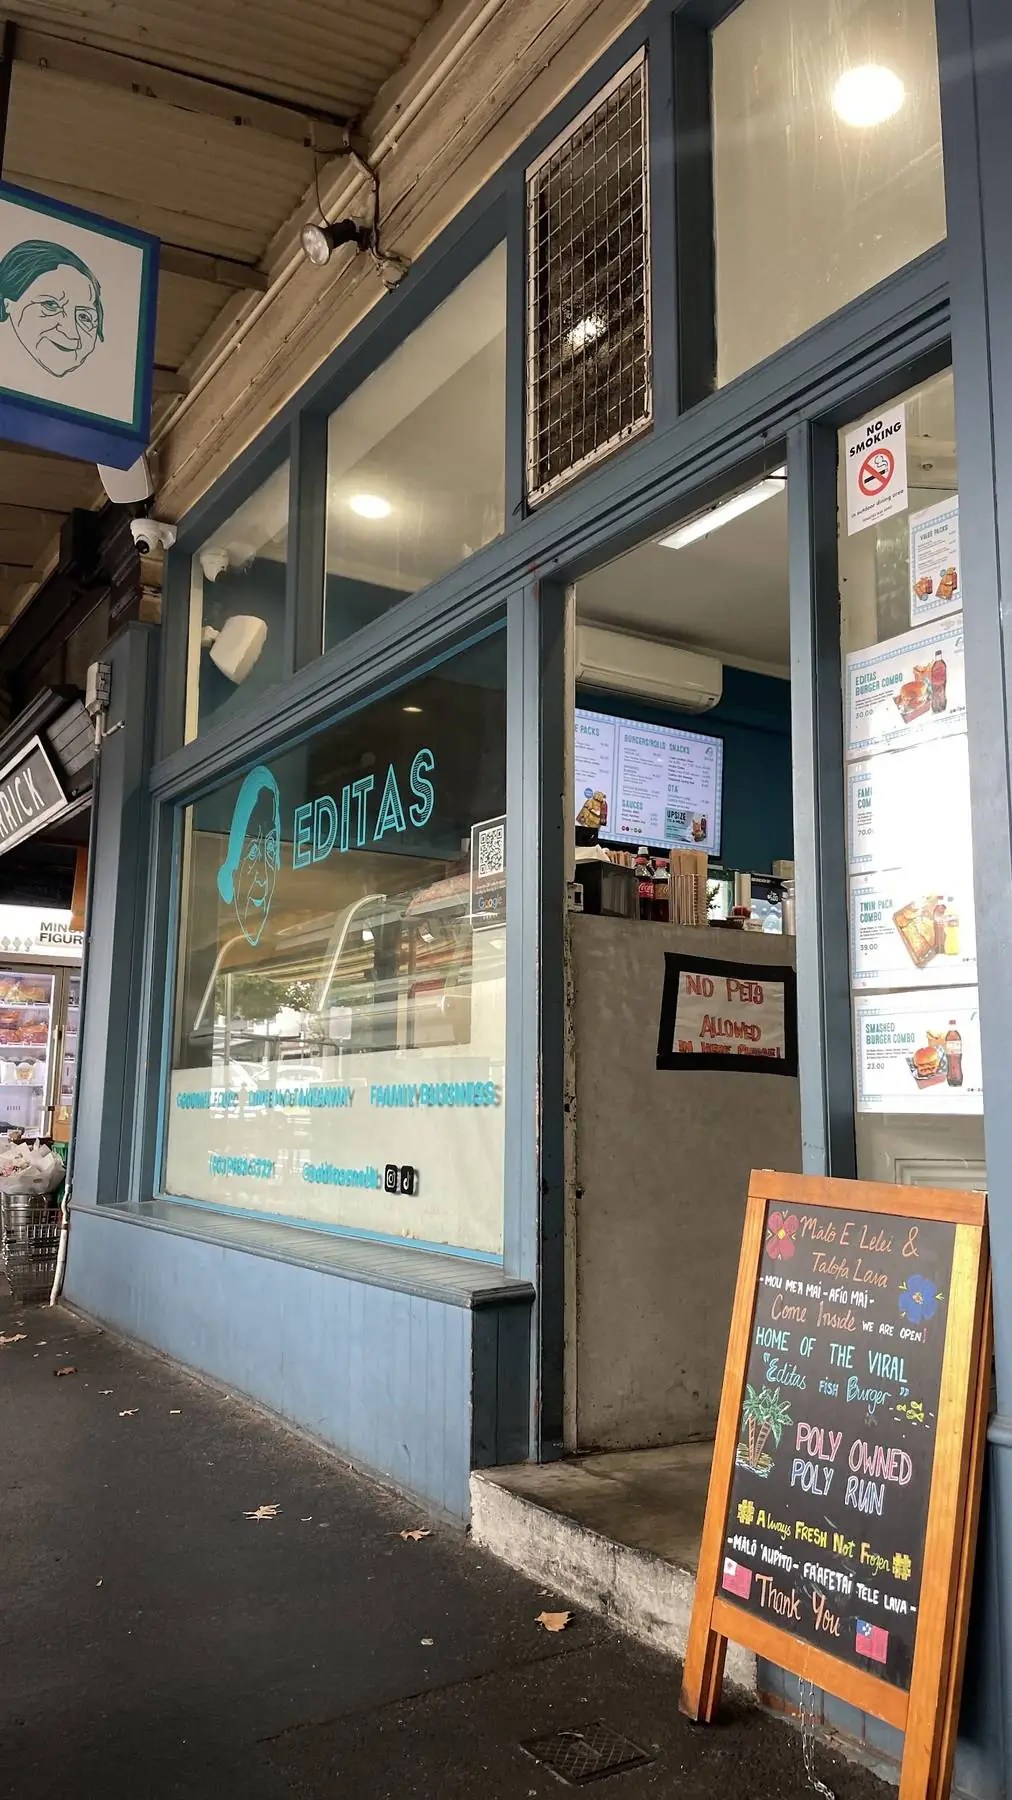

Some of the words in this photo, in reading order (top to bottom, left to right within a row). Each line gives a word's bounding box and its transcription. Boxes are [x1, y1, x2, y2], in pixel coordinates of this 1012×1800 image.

[849, 422, 902, 457] SMOKING
[866, 420, 883, 437] NO
[876, 495, 892, 507] dining
[892, 489, 904, 499] area
[855, 671, 877, 686] EDITAS
[855, 680, 881, 697] BURGER
[881, 672, 904, 687] COMBO
[580, 724, 600, 737] PACKS
[293, 748, 435, 870] EDITAS
[859, 902, 876, 913] TWIN
[877, 899, 893, 910] PACK
[860, 911, 882, 923] COMBO
[685, 974, 715, 998] NO
[726, 978, 764, 1005] PETS
[699, 1014, 762, 1042] ALLOWED
[865, 1022, 896, 1034] SMASHED
[866, 1034, 892, 1045] BURGER
[892, 1032, 916, 1044] COMBO
[370, 1084, 420, 1108] FAMILY
[419, 1081, 499, 1107] BUSINESS
[839, 1222, 855, 1246] E
[902, 1225, 920, 1257] &
[812, 1252, 849, 1280] Talofa
[853, 1258, 889, 1288] Lava
[771, 1293, 807, 1324] Come
[816, 1301, 857, 1332] Inside
[862, 1320, 875, 1334] WE
[878, 1323, 894, 1338] ARE
[899, 1328, 928, 1344] OPEN!
[755, 1326, 791, 1351] HOME
[800, 1336, 817, 1358] OF
[829, 1343, 855, 1369] THE
[868, 1350, 908, 1383] VIRAL
[795, 1422, 843, 1462] POLY
[848, 1438, 913, 1486] OWNED
[790, 1458, 834, 1497] POLY
[844, 1475, 886, 1516] RUN
[832, 1532, 856, 1560] Not
[755, 1573, 801, 1621] Thank
[812, 1591, 841, 1638] You
[855, 1582, 880, 1606] TELE
[883, 1594, 907, 1615] LAVA
